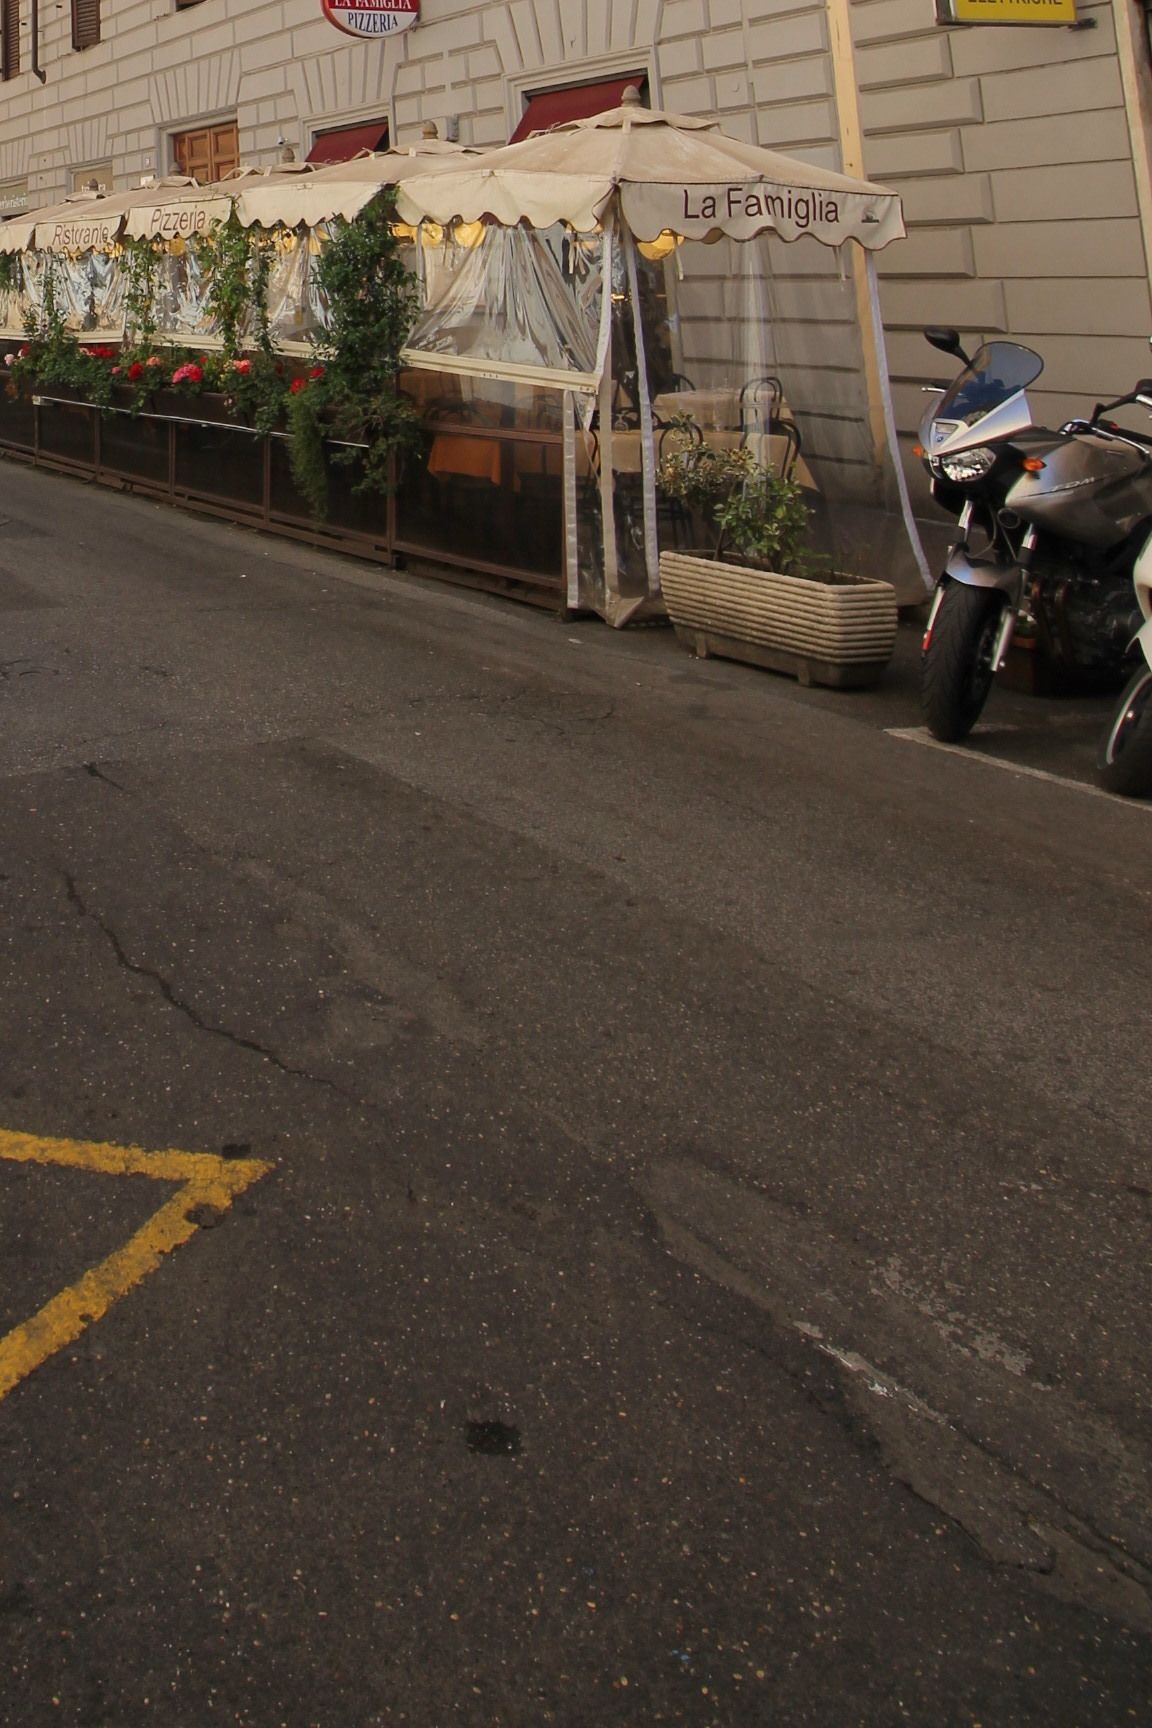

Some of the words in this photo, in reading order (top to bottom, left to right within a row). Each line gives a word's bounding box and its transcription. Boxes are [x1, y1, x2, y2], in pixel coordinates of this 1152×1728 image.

[348, 13, 398, 32] PIZZERIA
[151, 205, 206, 232] Pizzeria
[683, 189, 716, 219] La
[727, 188, 840, 228] Famiglia
[52, 224, 109, 246] Ristorante
